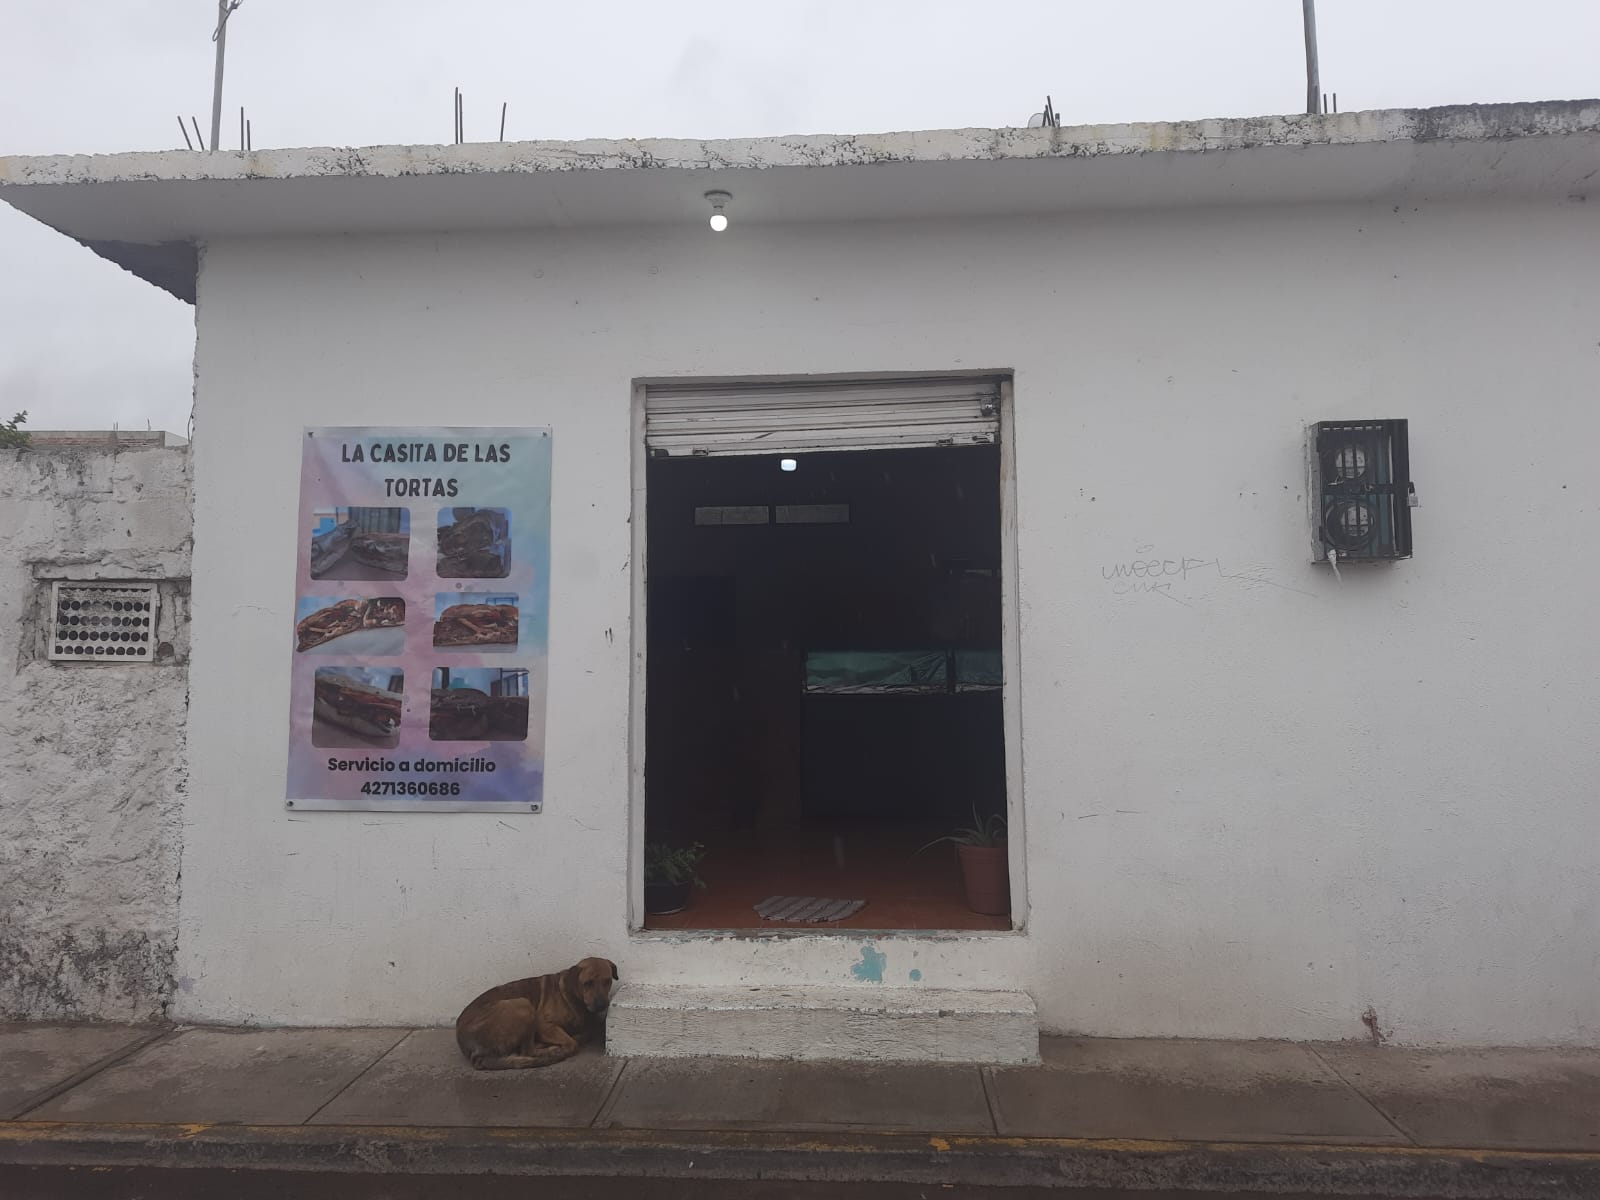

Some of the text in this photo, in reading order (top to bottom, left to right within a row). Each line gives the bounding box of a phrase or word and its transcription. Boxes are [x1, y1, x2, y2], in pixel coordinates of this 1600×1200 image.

[341, 443, 511, 462] LA CASITA DE LAS
[384, 478, 459, 497] TORTAS
[328, 757, 496, 773] Servicio a domicilio
[361, 781, 460, 795] 4271360686
